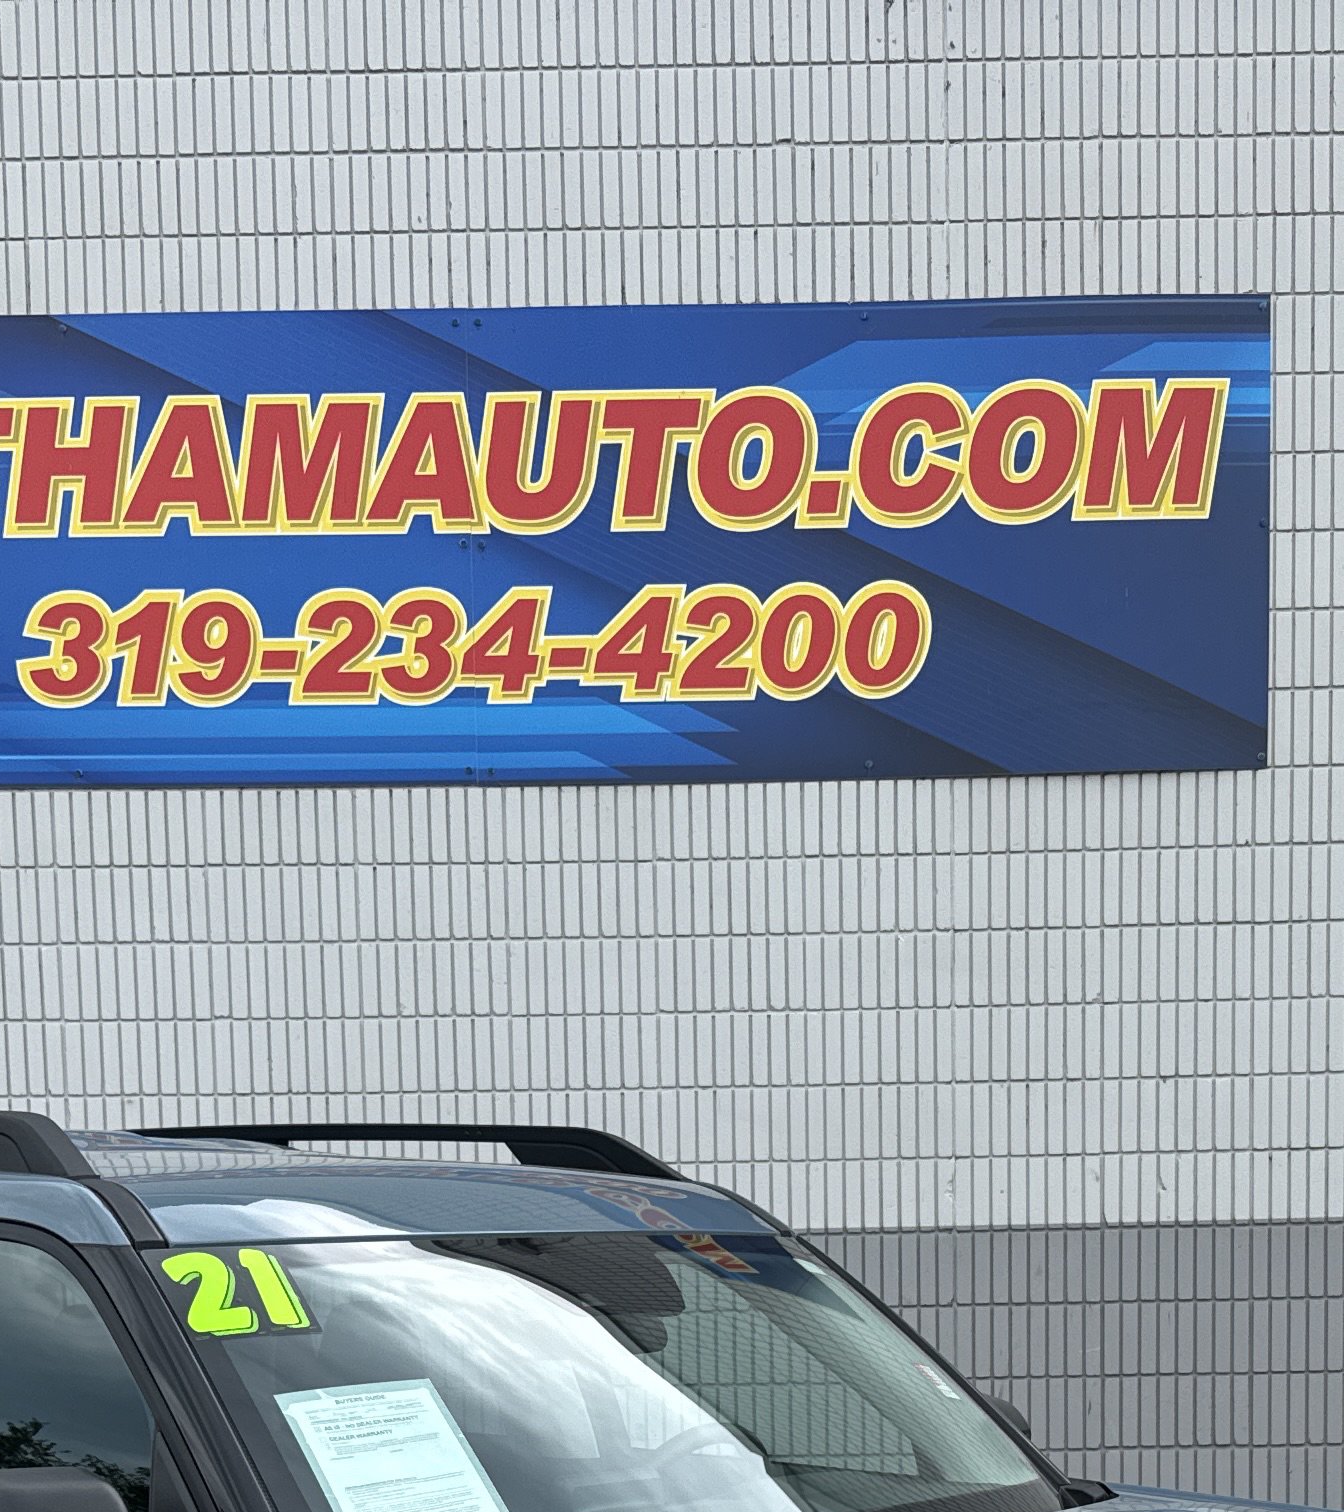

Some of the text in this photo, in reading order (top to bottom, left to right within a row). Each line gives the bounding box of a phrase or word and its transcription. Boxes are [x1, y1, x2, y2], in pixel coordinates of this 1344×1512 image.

[20, 580, 931, 709] 319-234-4200
[162, 1248, 310, 1336] 21
[328, 1429, 393, 1441] DEALER WARRANTY
[355, 1419, 382, 1428] DEALER
[383, 1415, 418, 1423] WARRANTY
